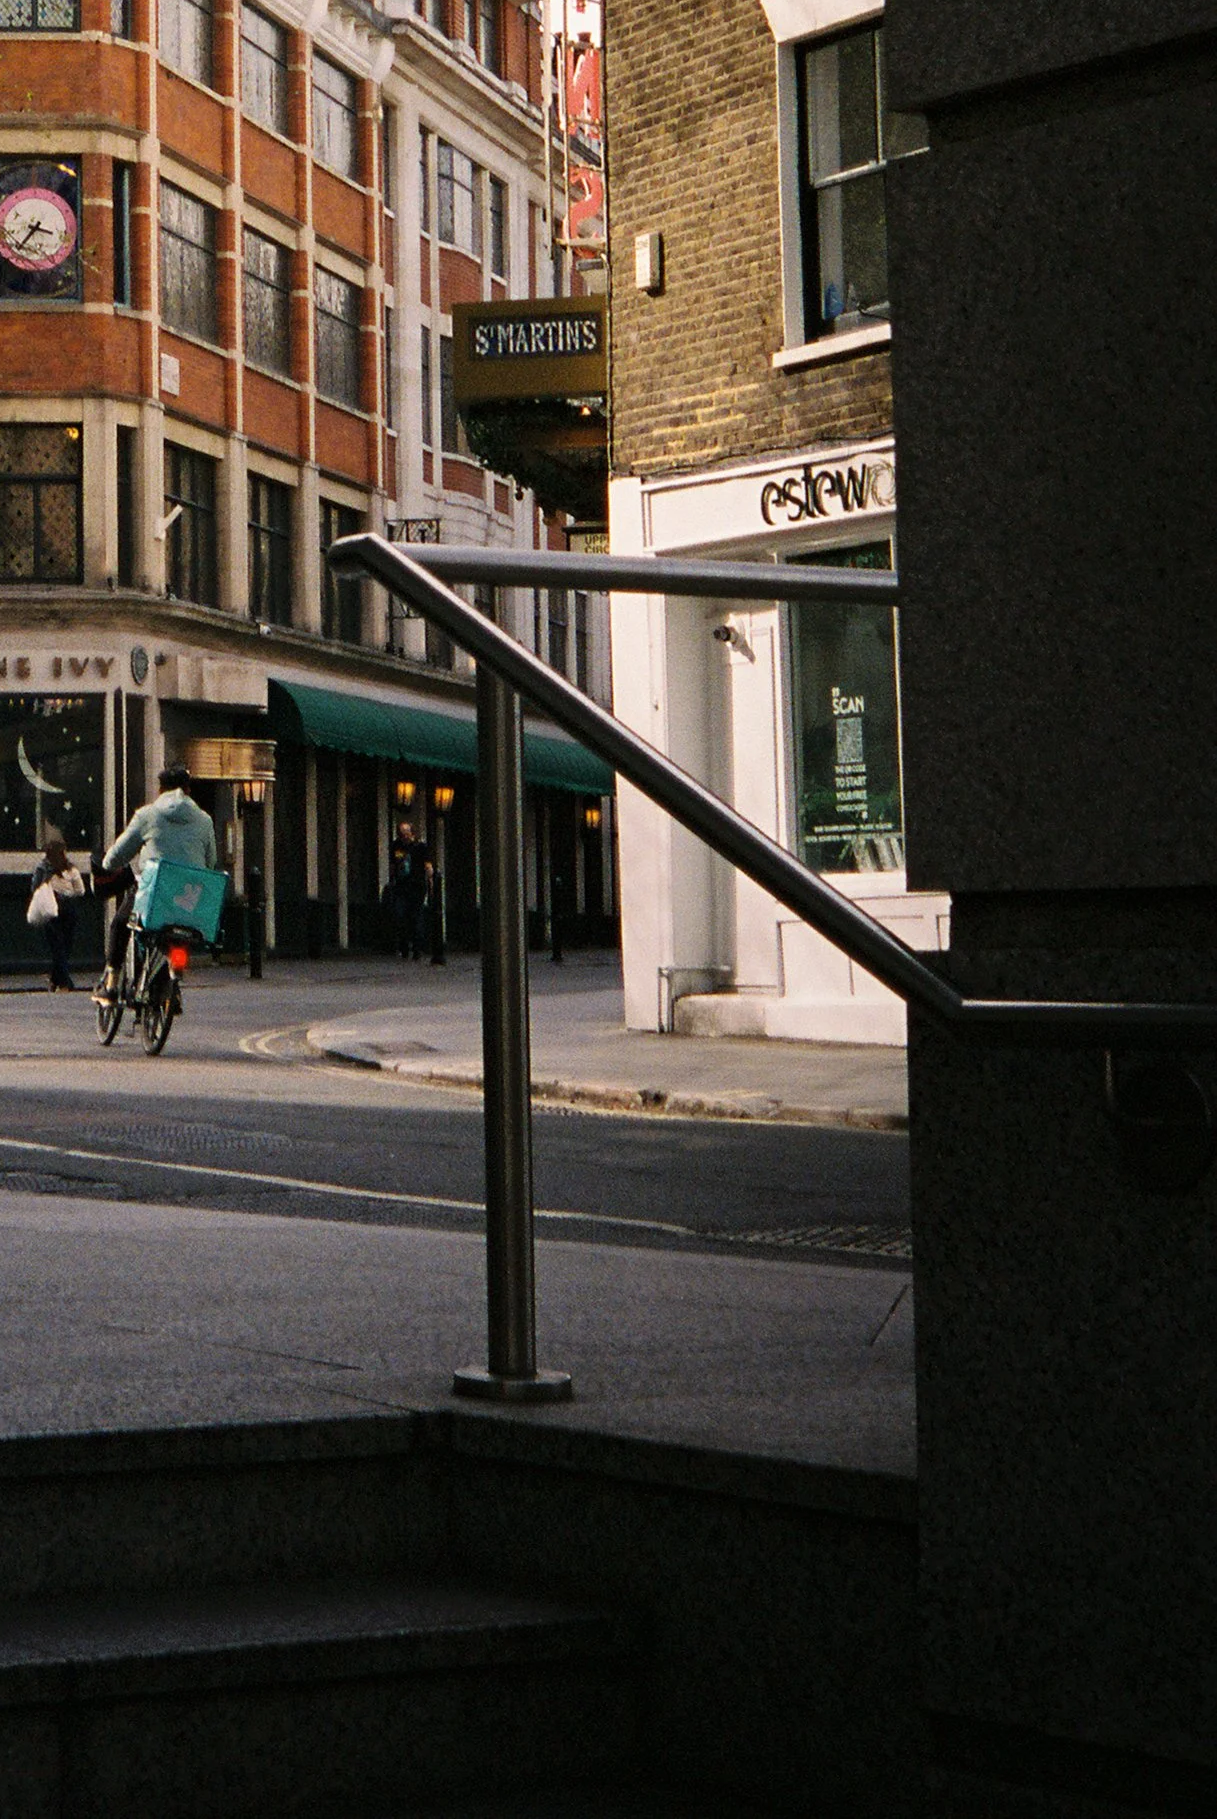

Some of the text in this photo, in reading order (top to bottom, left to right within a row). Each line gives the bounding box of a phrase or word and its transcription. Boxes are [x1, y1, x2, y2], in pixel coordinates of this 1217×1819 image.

[52, 656, 115, 680] IVY
[832, 695, 865, 715] SCAN
[835, 776, 867, 788] TO START
